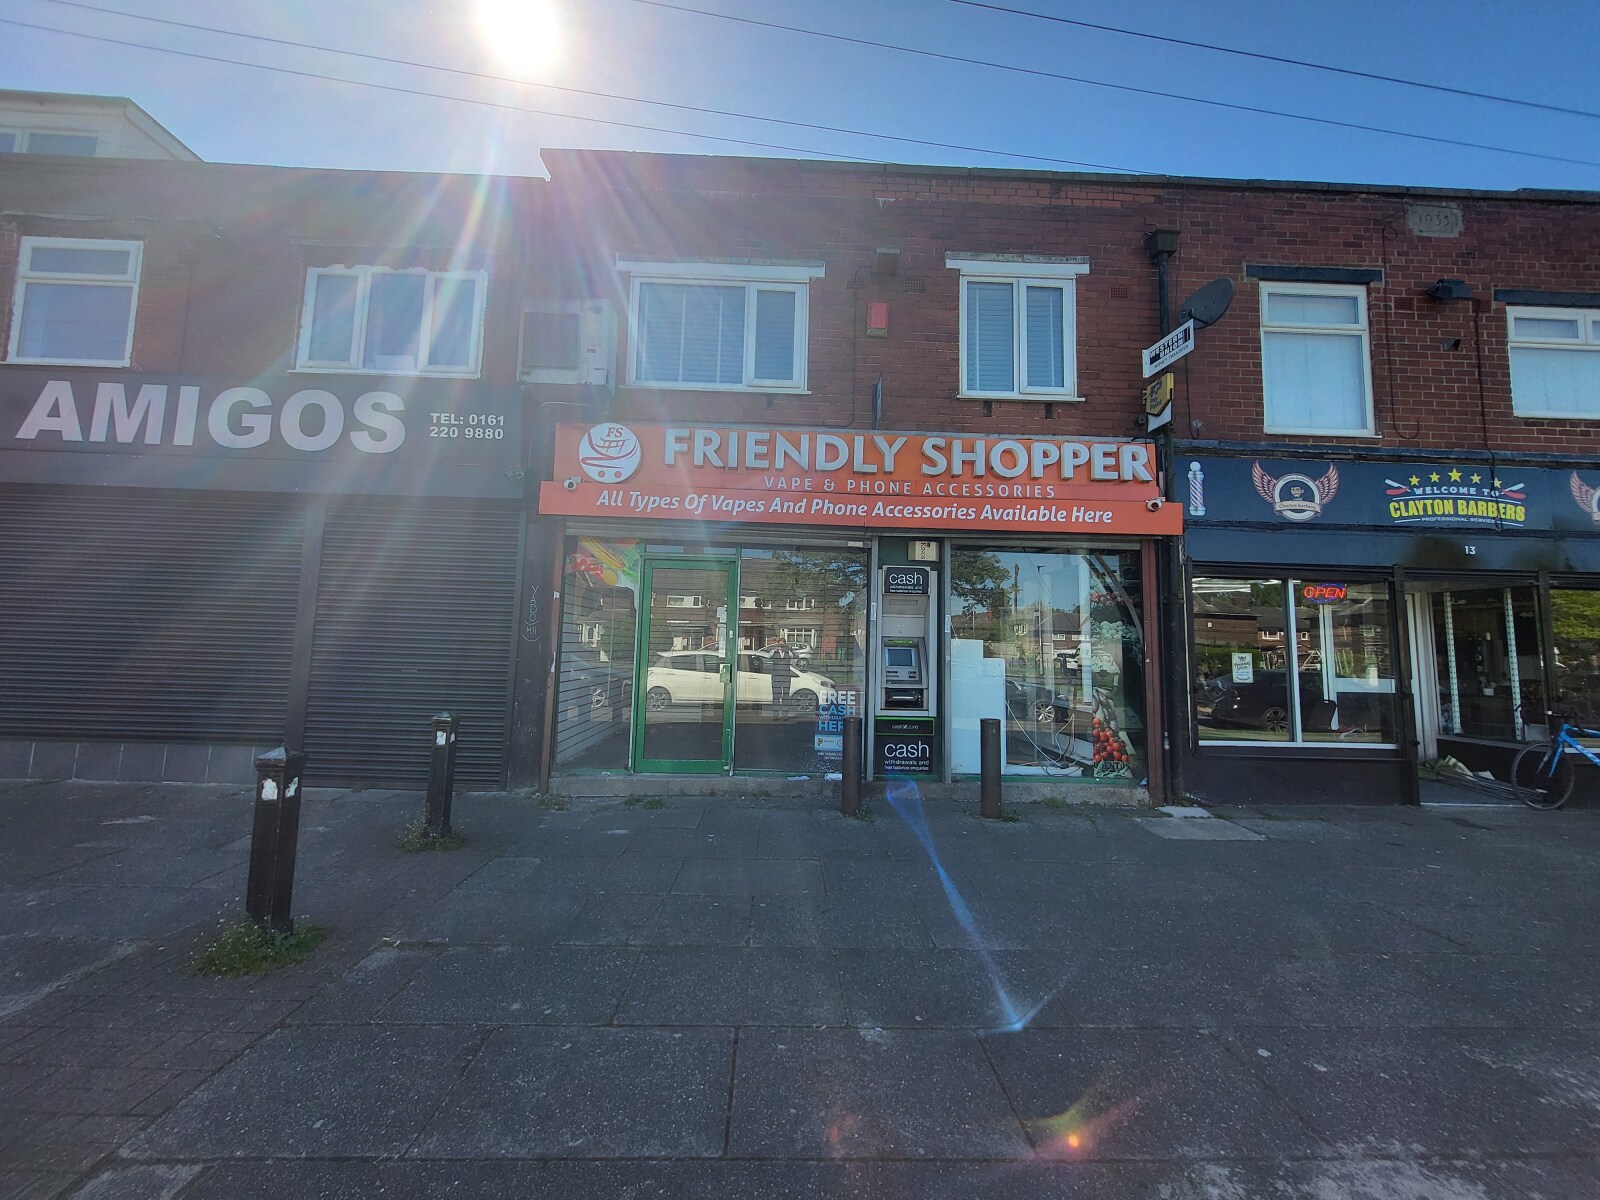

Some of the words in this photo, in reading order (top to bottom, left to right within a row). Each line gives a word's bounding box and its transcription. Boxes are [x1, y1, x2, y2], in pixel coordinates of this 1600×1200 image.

[1150, 329, 1185, 358] WESTERN
[1159, 339, 1184, 358] UNION
[15, 379, 406, 454] AMIGOS
[430, 412, 464, 425] TEL:
[468, 413, 504, 426] 0161
[429, 426, 459, 438] 220
[464, 427, 504, 440] 9880
[605, 426, 624, 438] FS
[664, 429, 908, 474] FRIENDLY
[921, 437, 1153, 481] SHOPPER
[764, 476, 813, 491] VAPE
[823, 478, 836, 491] &
[847, 479, 911, 495] PHONE
[922, 482, 1056, 499] ACCESSORIES
[1413, 486, 1477, 496] WELCOME
[596, 490, 624, 507] All
[629, 491, 680, 512] Types
[684, 493, 708, 515] Of
[711, 495, 766, 516] Vapes
[768, 497, 807, 515] And
[810, 498, 868, 517] Phone
[871, 501, 977, 521] Accessories
[980, 504, 1067, 523] Available
[1071, 506, 1113, 523] Here
[1389, 500, 1453, 518] CLAYTON
[1457, 500, 1526, 522] BARBERS
[1464, 545, 1476, 555] 13
[889, 571, 923, 585] cash
[1304, 583, 1346, 599] OPEN
[819, 690, 856, 705] FREE
[819, 704, 856, 716] CASH
[884, 740, 930, 758] cash
